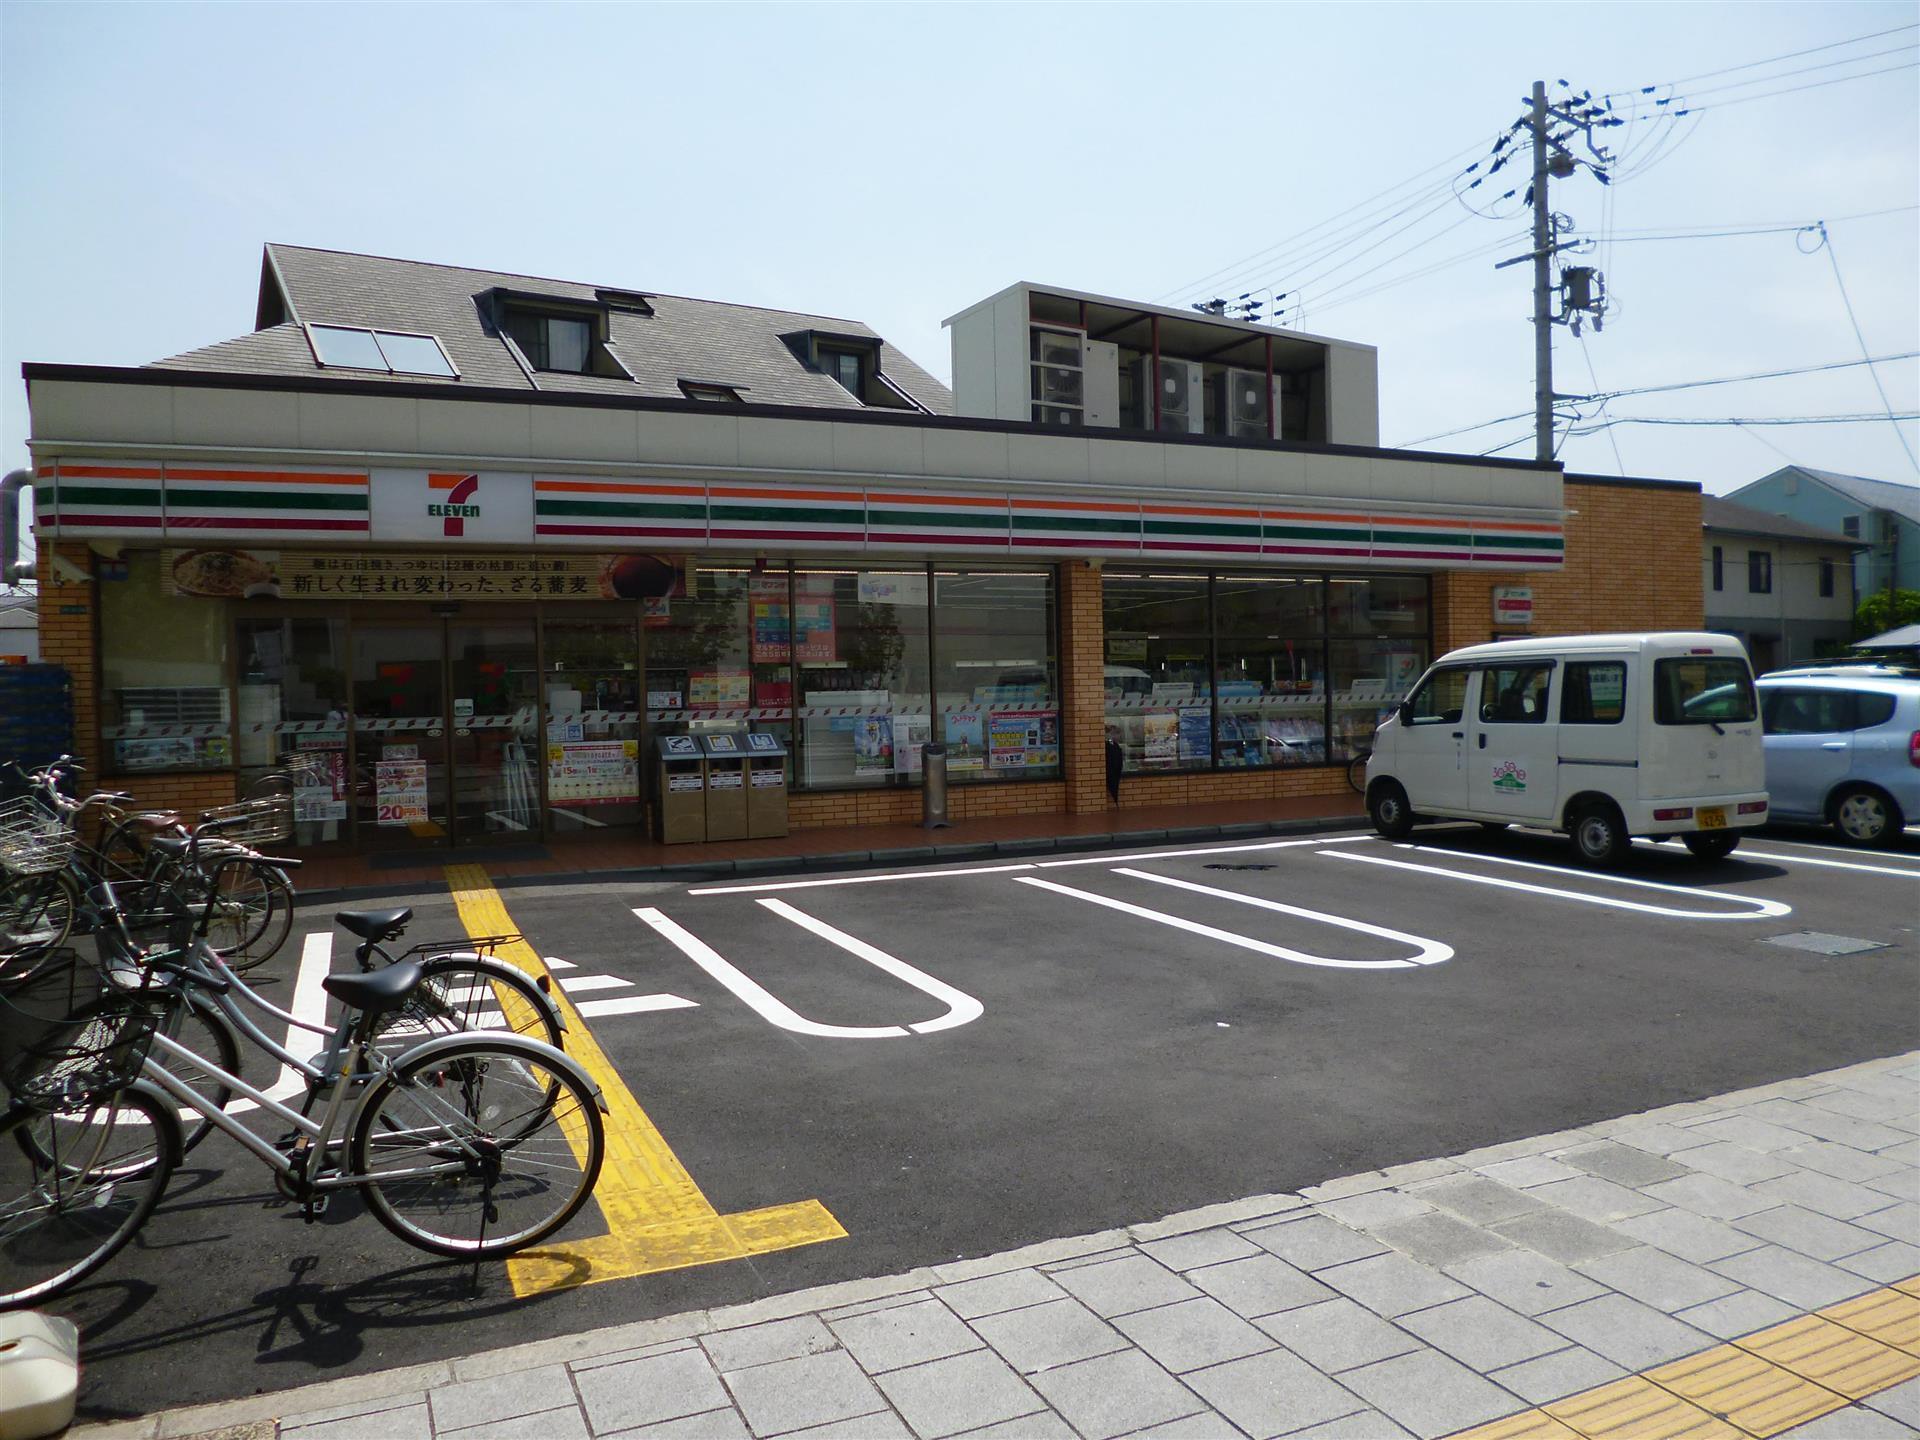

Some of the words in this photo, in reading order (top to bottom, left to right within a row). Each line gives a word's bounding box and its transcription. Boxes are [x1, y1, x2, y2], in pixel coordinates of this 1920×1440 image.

[428, 474, 479, 537] 7
[293, 574, 588, 594] 新しく生まれ変わった、ざる蕎麦
